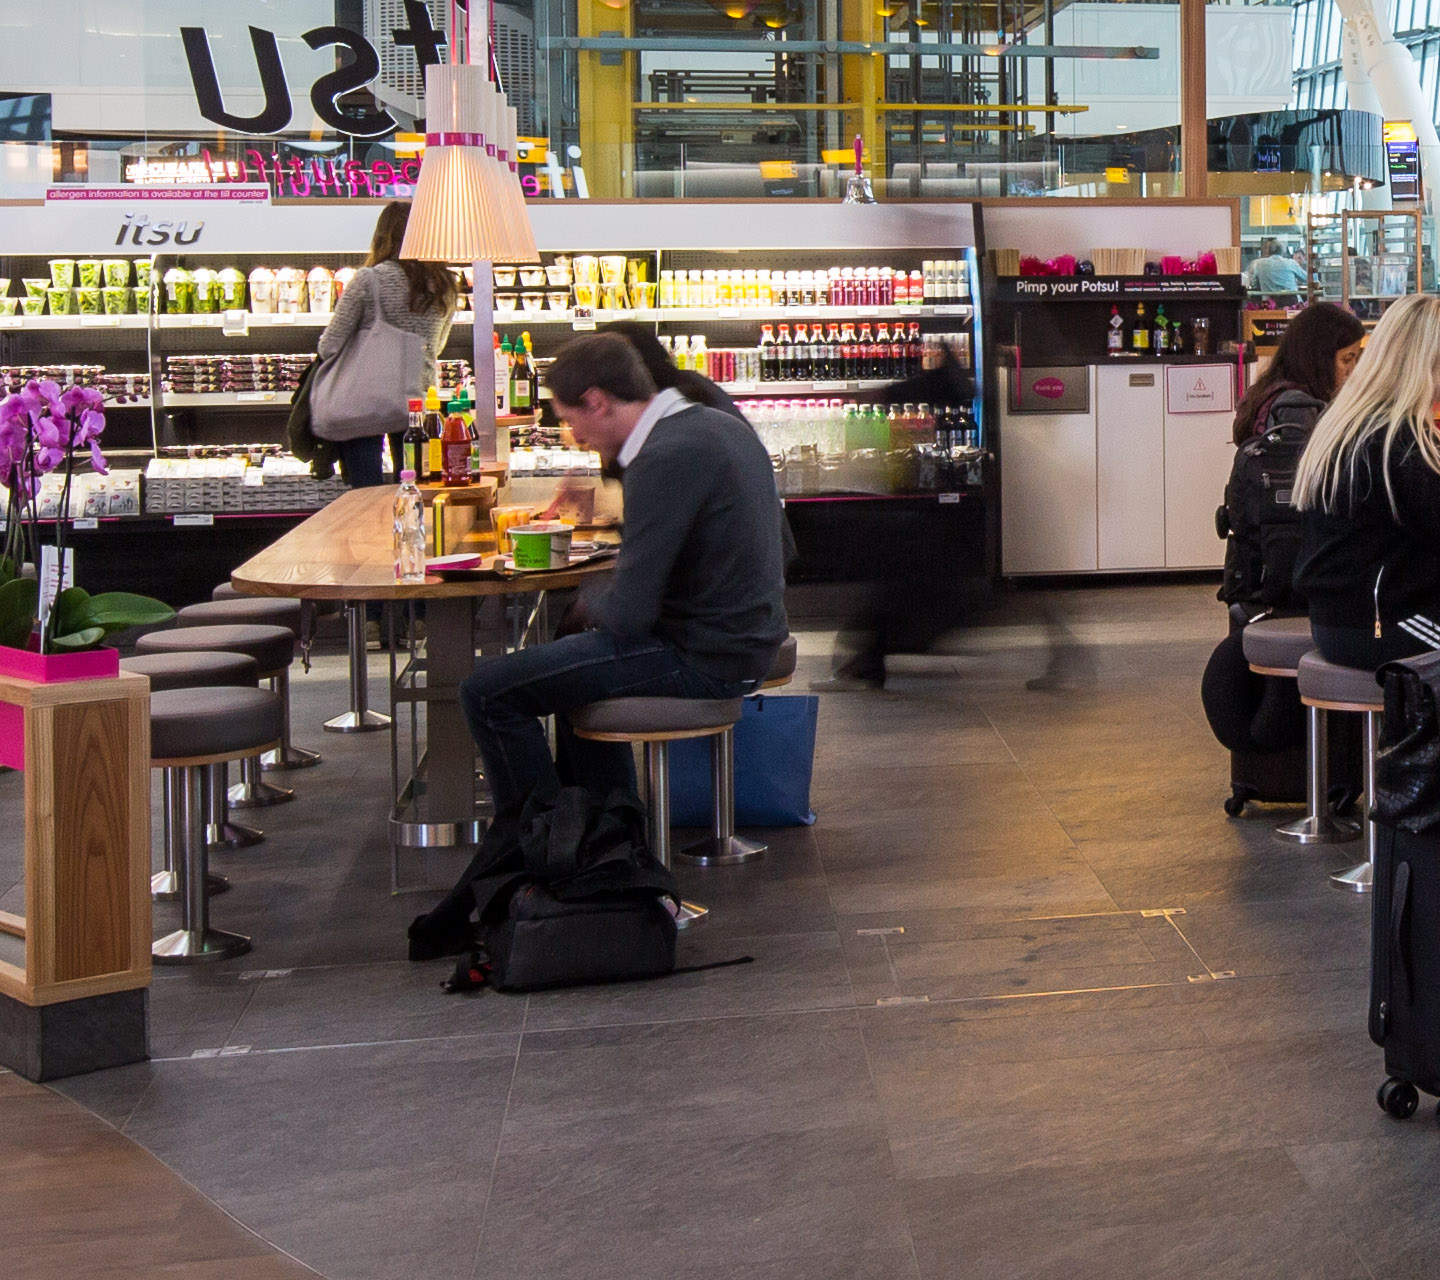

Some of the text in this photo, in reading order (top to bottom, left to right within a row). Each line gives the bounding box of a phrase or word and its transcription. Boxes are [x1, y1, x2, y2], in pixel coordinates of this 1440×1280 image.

[49, 189, 266, 200] allergen information is available at the till counter
[114, 211, 206, 246] itsu
[1016, 280, 1120, 296] Pimp your Potsu!
